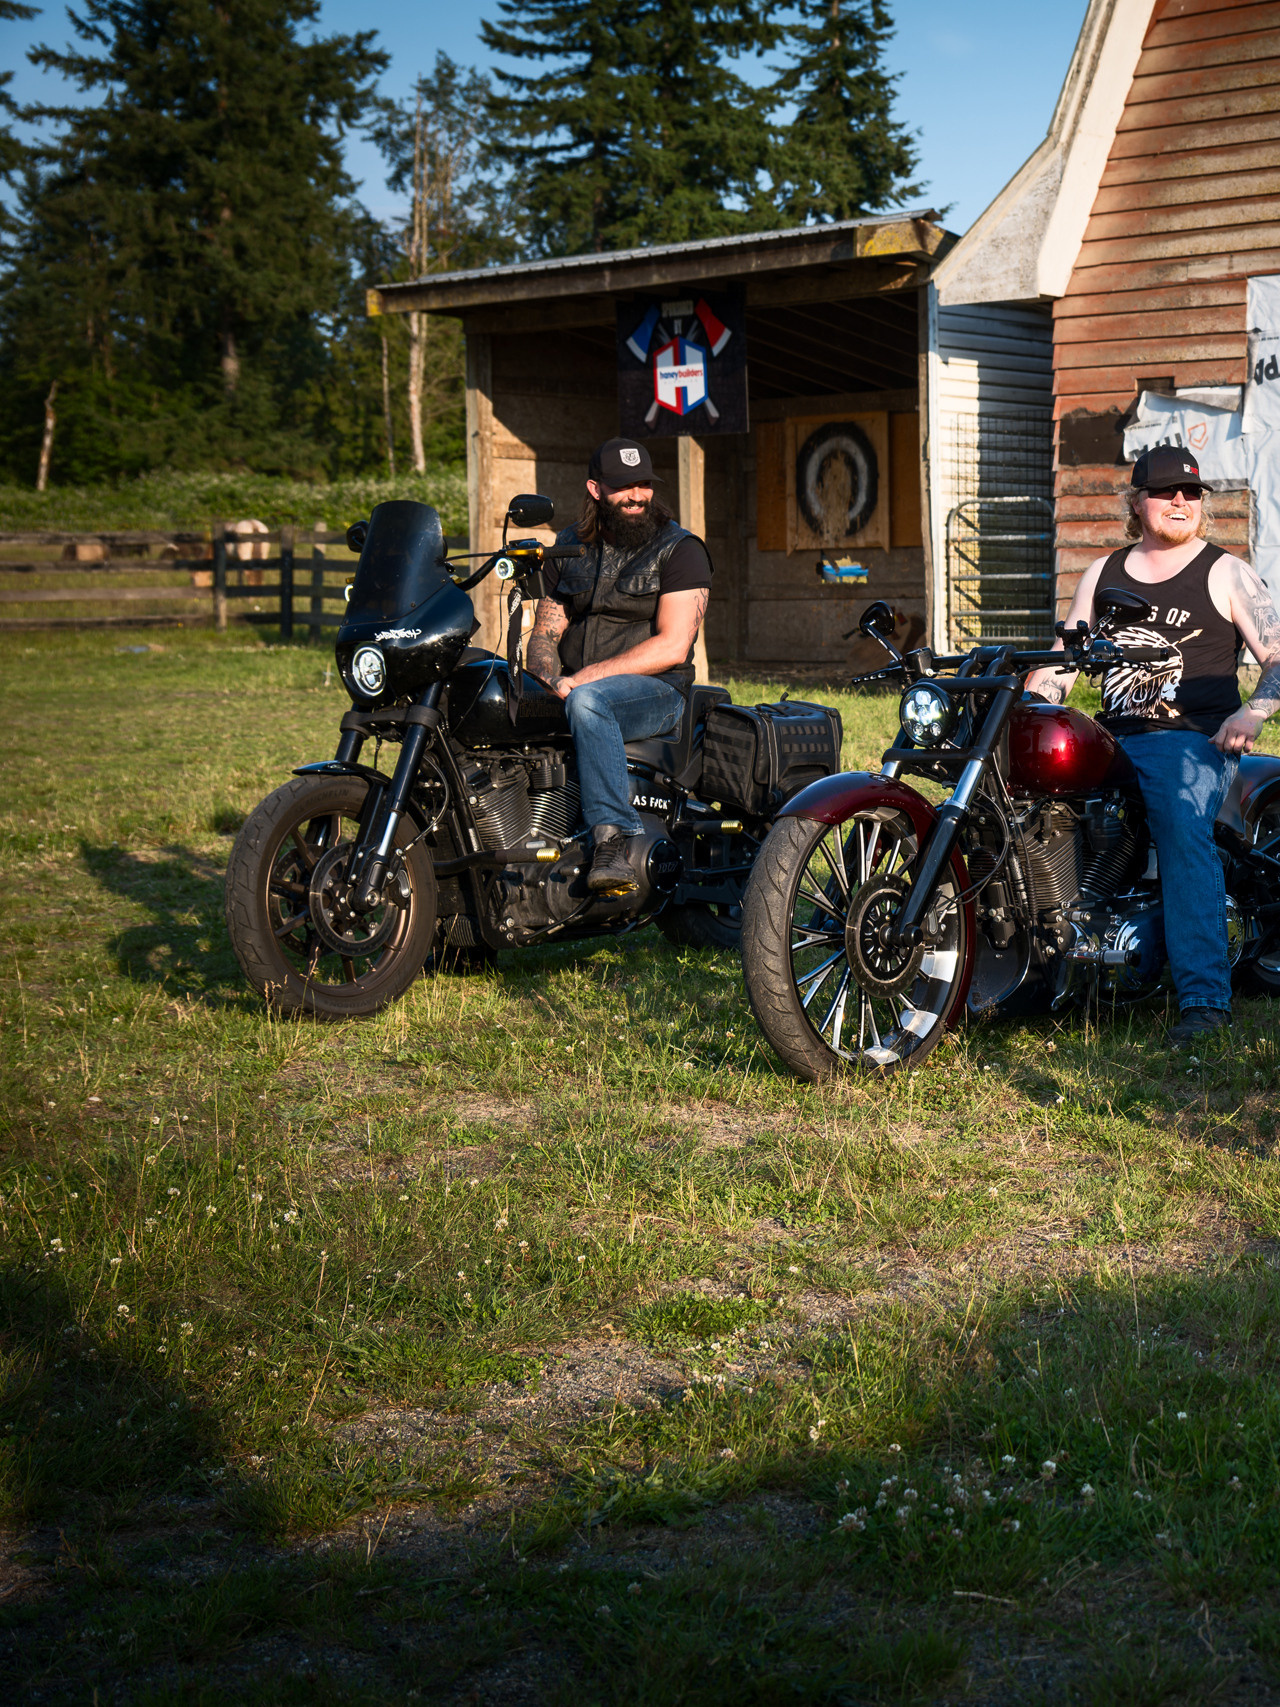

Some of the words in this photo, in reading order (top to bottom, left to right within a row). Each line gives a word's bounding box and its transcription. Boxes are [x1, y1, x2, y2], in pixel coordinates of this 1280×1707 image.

[660, 368, 703, 381] haneybuilders
[1165, 607, 1191, 628] OF
[633, 794, 647, 806] AS
